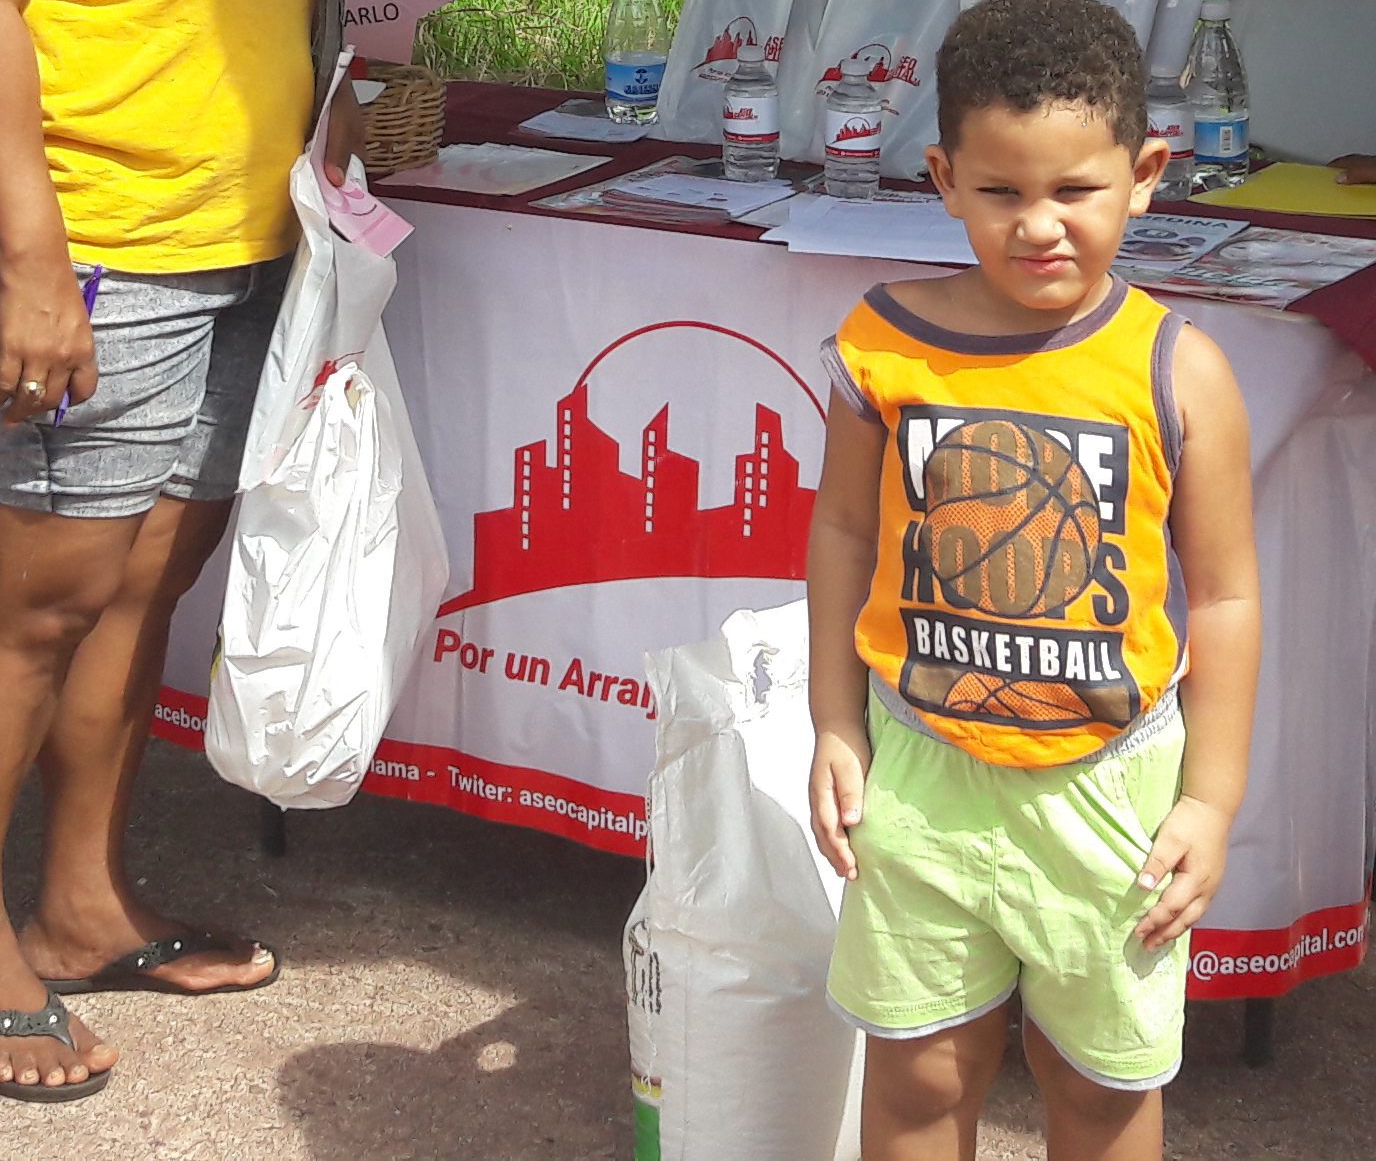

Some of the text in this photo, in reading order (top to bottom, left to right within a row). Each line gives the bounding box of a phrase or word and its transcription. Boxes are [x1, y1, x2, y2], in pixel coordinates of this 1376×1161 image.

[344, 2, 400, 28] ARLO
[903, 521, 1129, 626] HOOPS
[433, 628, 658, 720] Por un Arrai
[913, 616, 1123, 682] BASKETBALL
[154, 703, 208, 733] acebo
[447, 765, 513, 804] Twiter:
[519, 789, 648, 841] aseocapitalp
